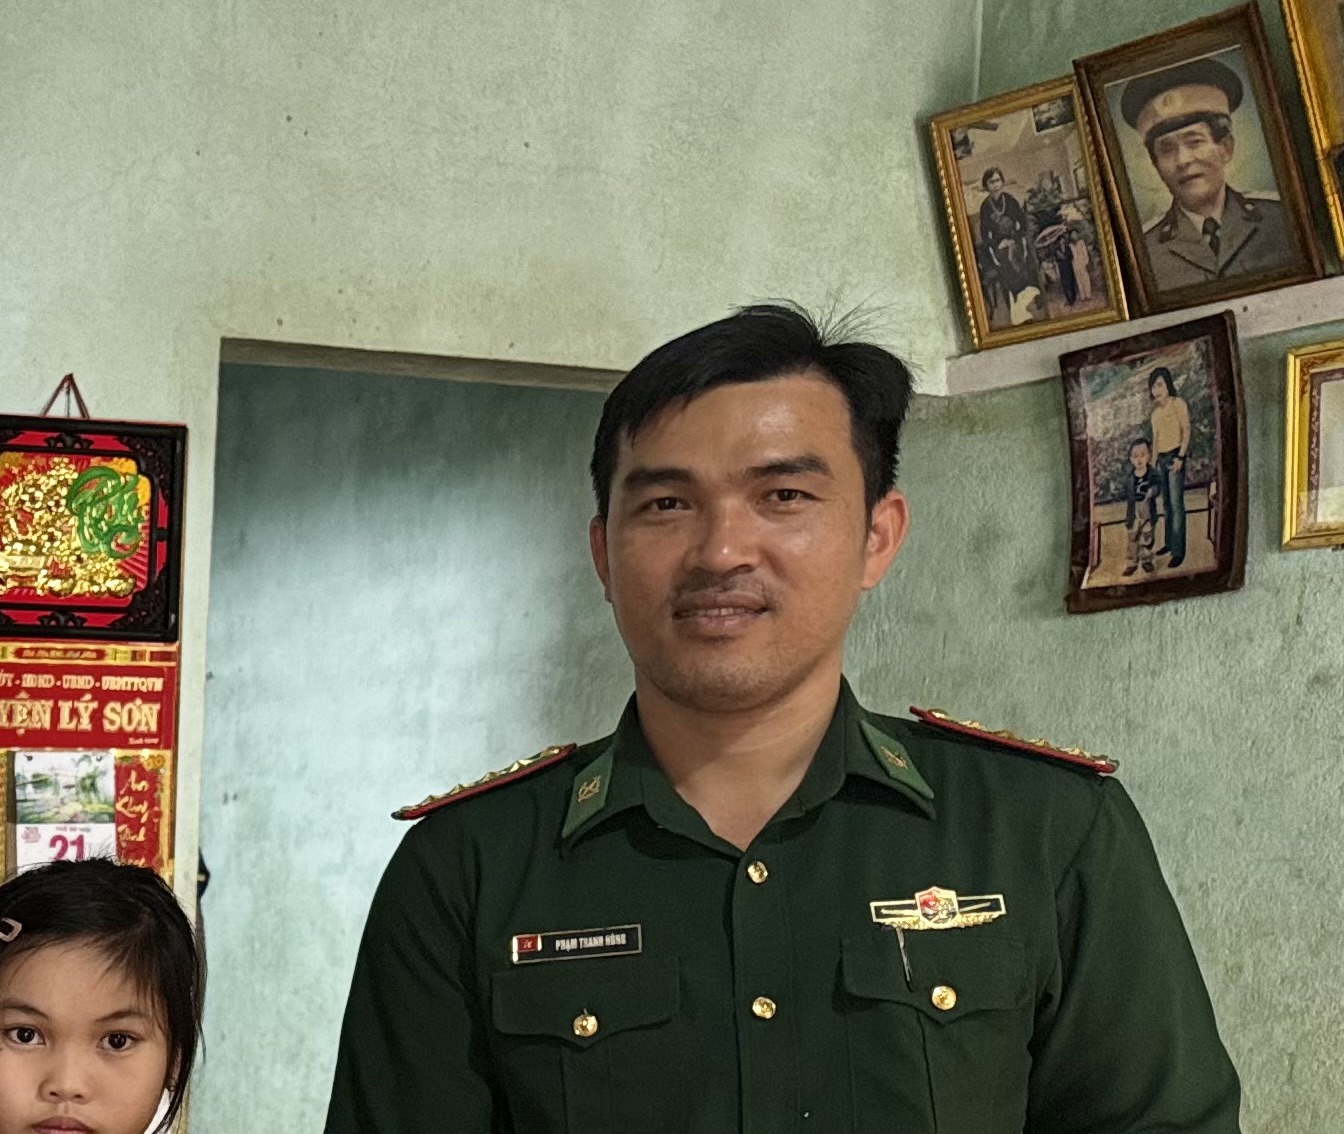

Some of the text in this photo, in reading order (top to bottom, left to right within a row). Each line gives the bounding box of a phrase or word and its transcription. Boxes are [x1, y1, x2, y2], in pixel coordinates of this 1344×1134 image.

[58, 693, 99, 733] LÝ
[103, 698, 161, 734] SƠN
[49, 834, 85, 862] 21
